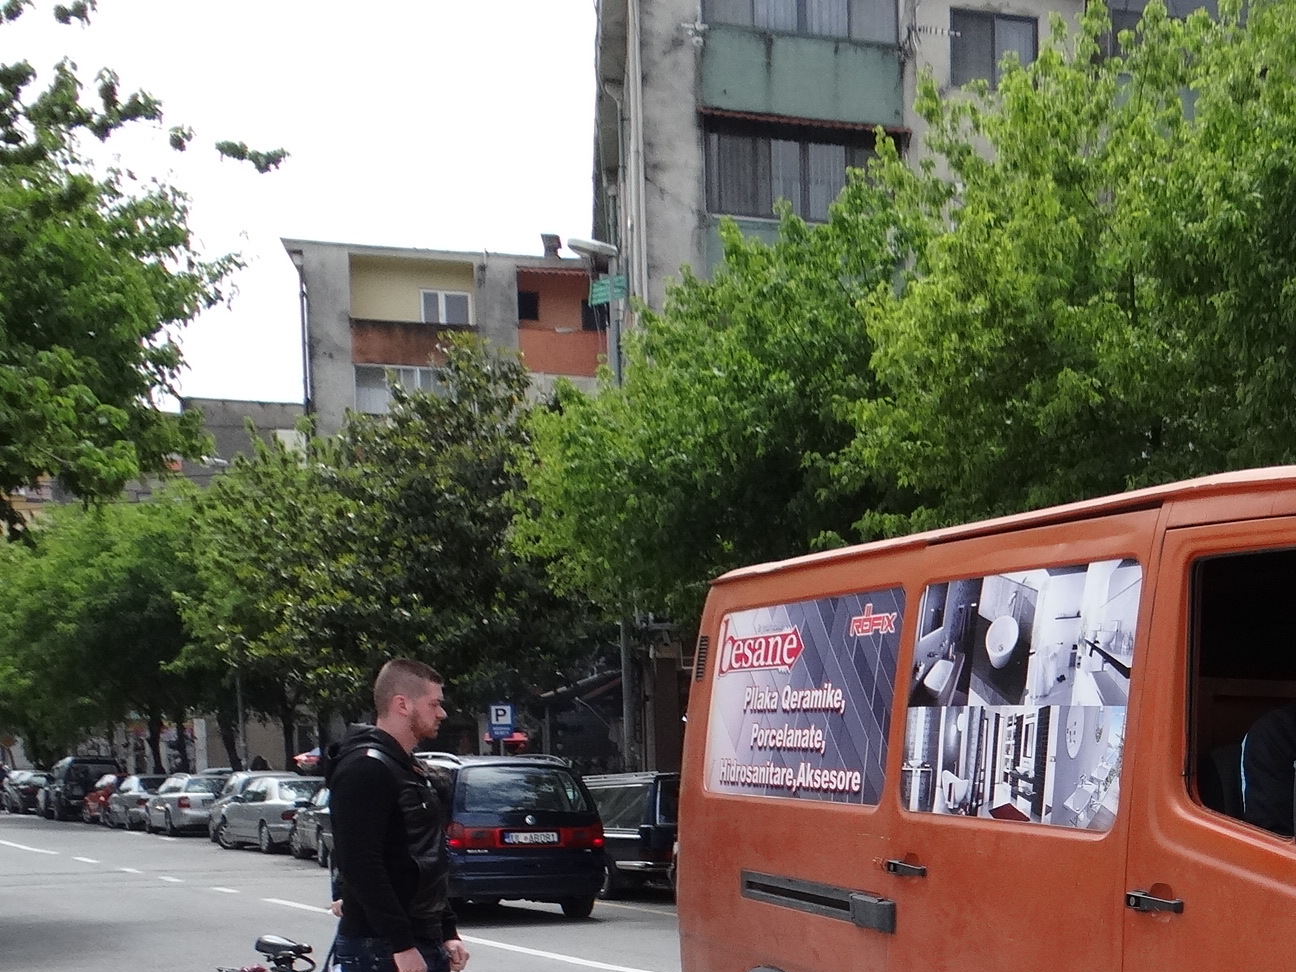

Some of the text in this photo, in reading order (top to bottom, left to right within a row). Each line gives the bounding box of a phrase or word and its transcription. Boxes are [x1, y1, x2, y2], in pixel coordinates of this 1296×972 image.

[743, 683, 846, 714] Pllaka Qeramike,
[494, 708, 507, 722] P
[750, 722, 826, 754] Porcelanate,
